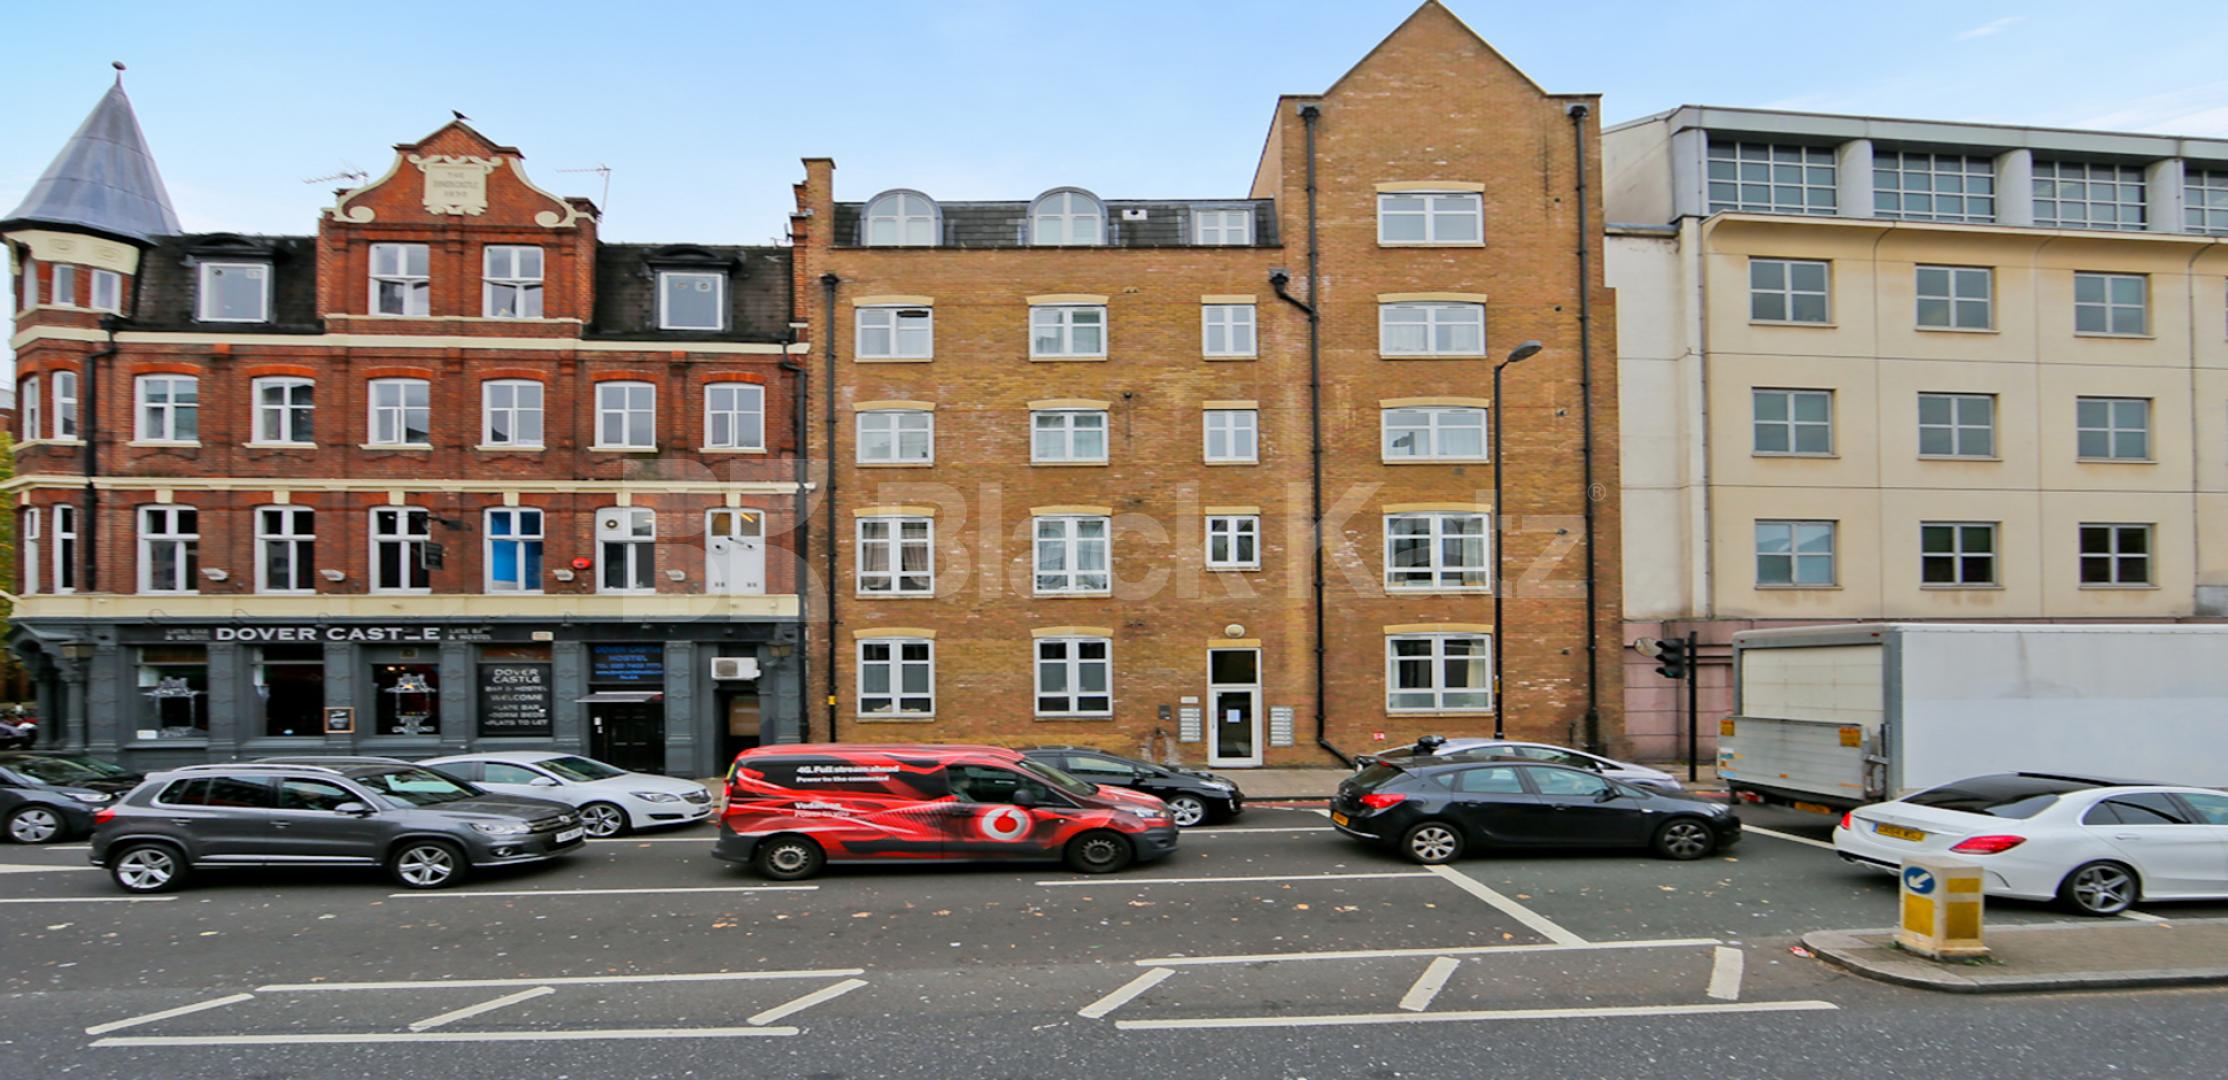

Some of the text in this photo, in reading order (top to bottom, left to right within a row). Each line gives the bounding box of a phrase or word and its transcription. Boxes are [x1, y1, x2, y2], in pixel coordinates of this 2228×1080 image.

[216, 627, 317, 641] DOVER
[494, 668, 539, 676] DOVER
[492, 676, 541, 684] CASTLE
[813, 765, 834, 774] Full
[869, 764, 900, 773] ahead
[848, 774, 890, 782] connected
